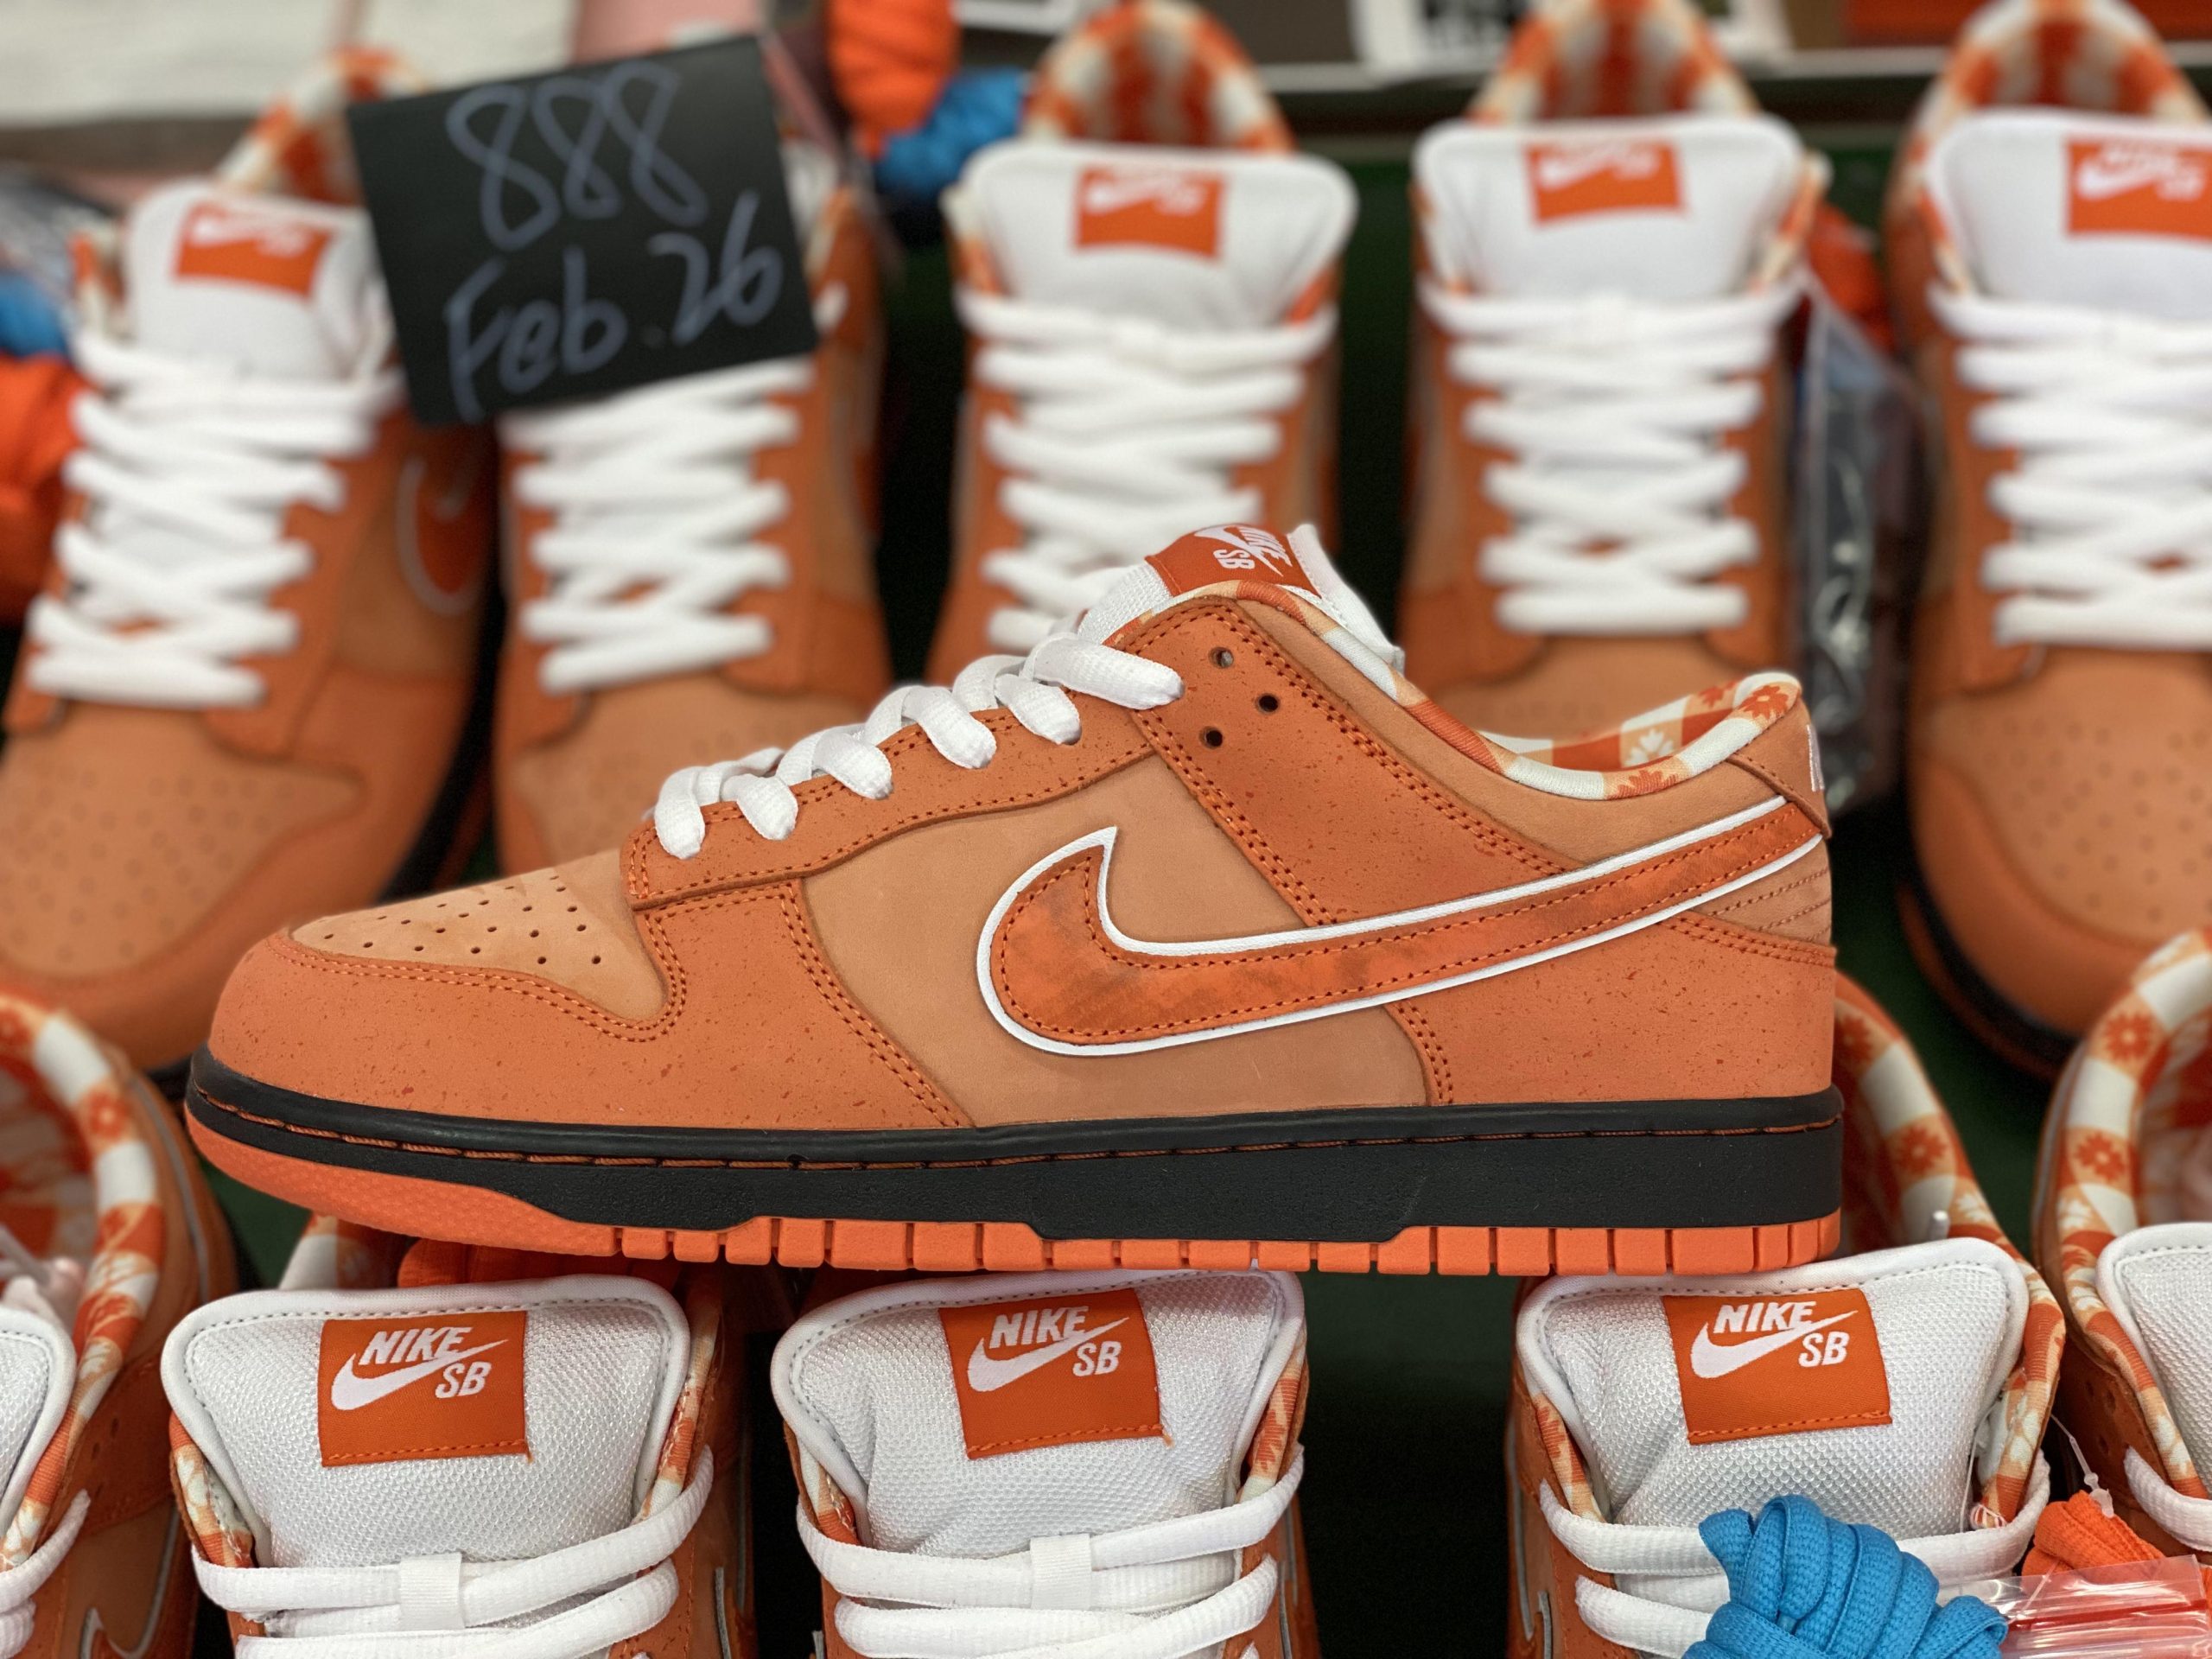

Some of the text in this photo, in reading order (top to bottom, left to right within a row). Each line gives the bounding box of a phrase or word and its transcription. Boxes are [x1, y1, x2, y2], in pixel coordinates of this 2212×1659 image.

[446, 60, 709, 251] 888
[1212, 549, 1255, 569] SB
[988, 1306, 1089, 1349] NIKE
[1713, 1300, 1816, 1334] NIKE
[358, 1326, 473, 1365] NIKE
[1072, 1341, 1122, 1376] SB
[1798, 1332, 1850, 1368] SB
[435, 1362, 492, 1399] SB
